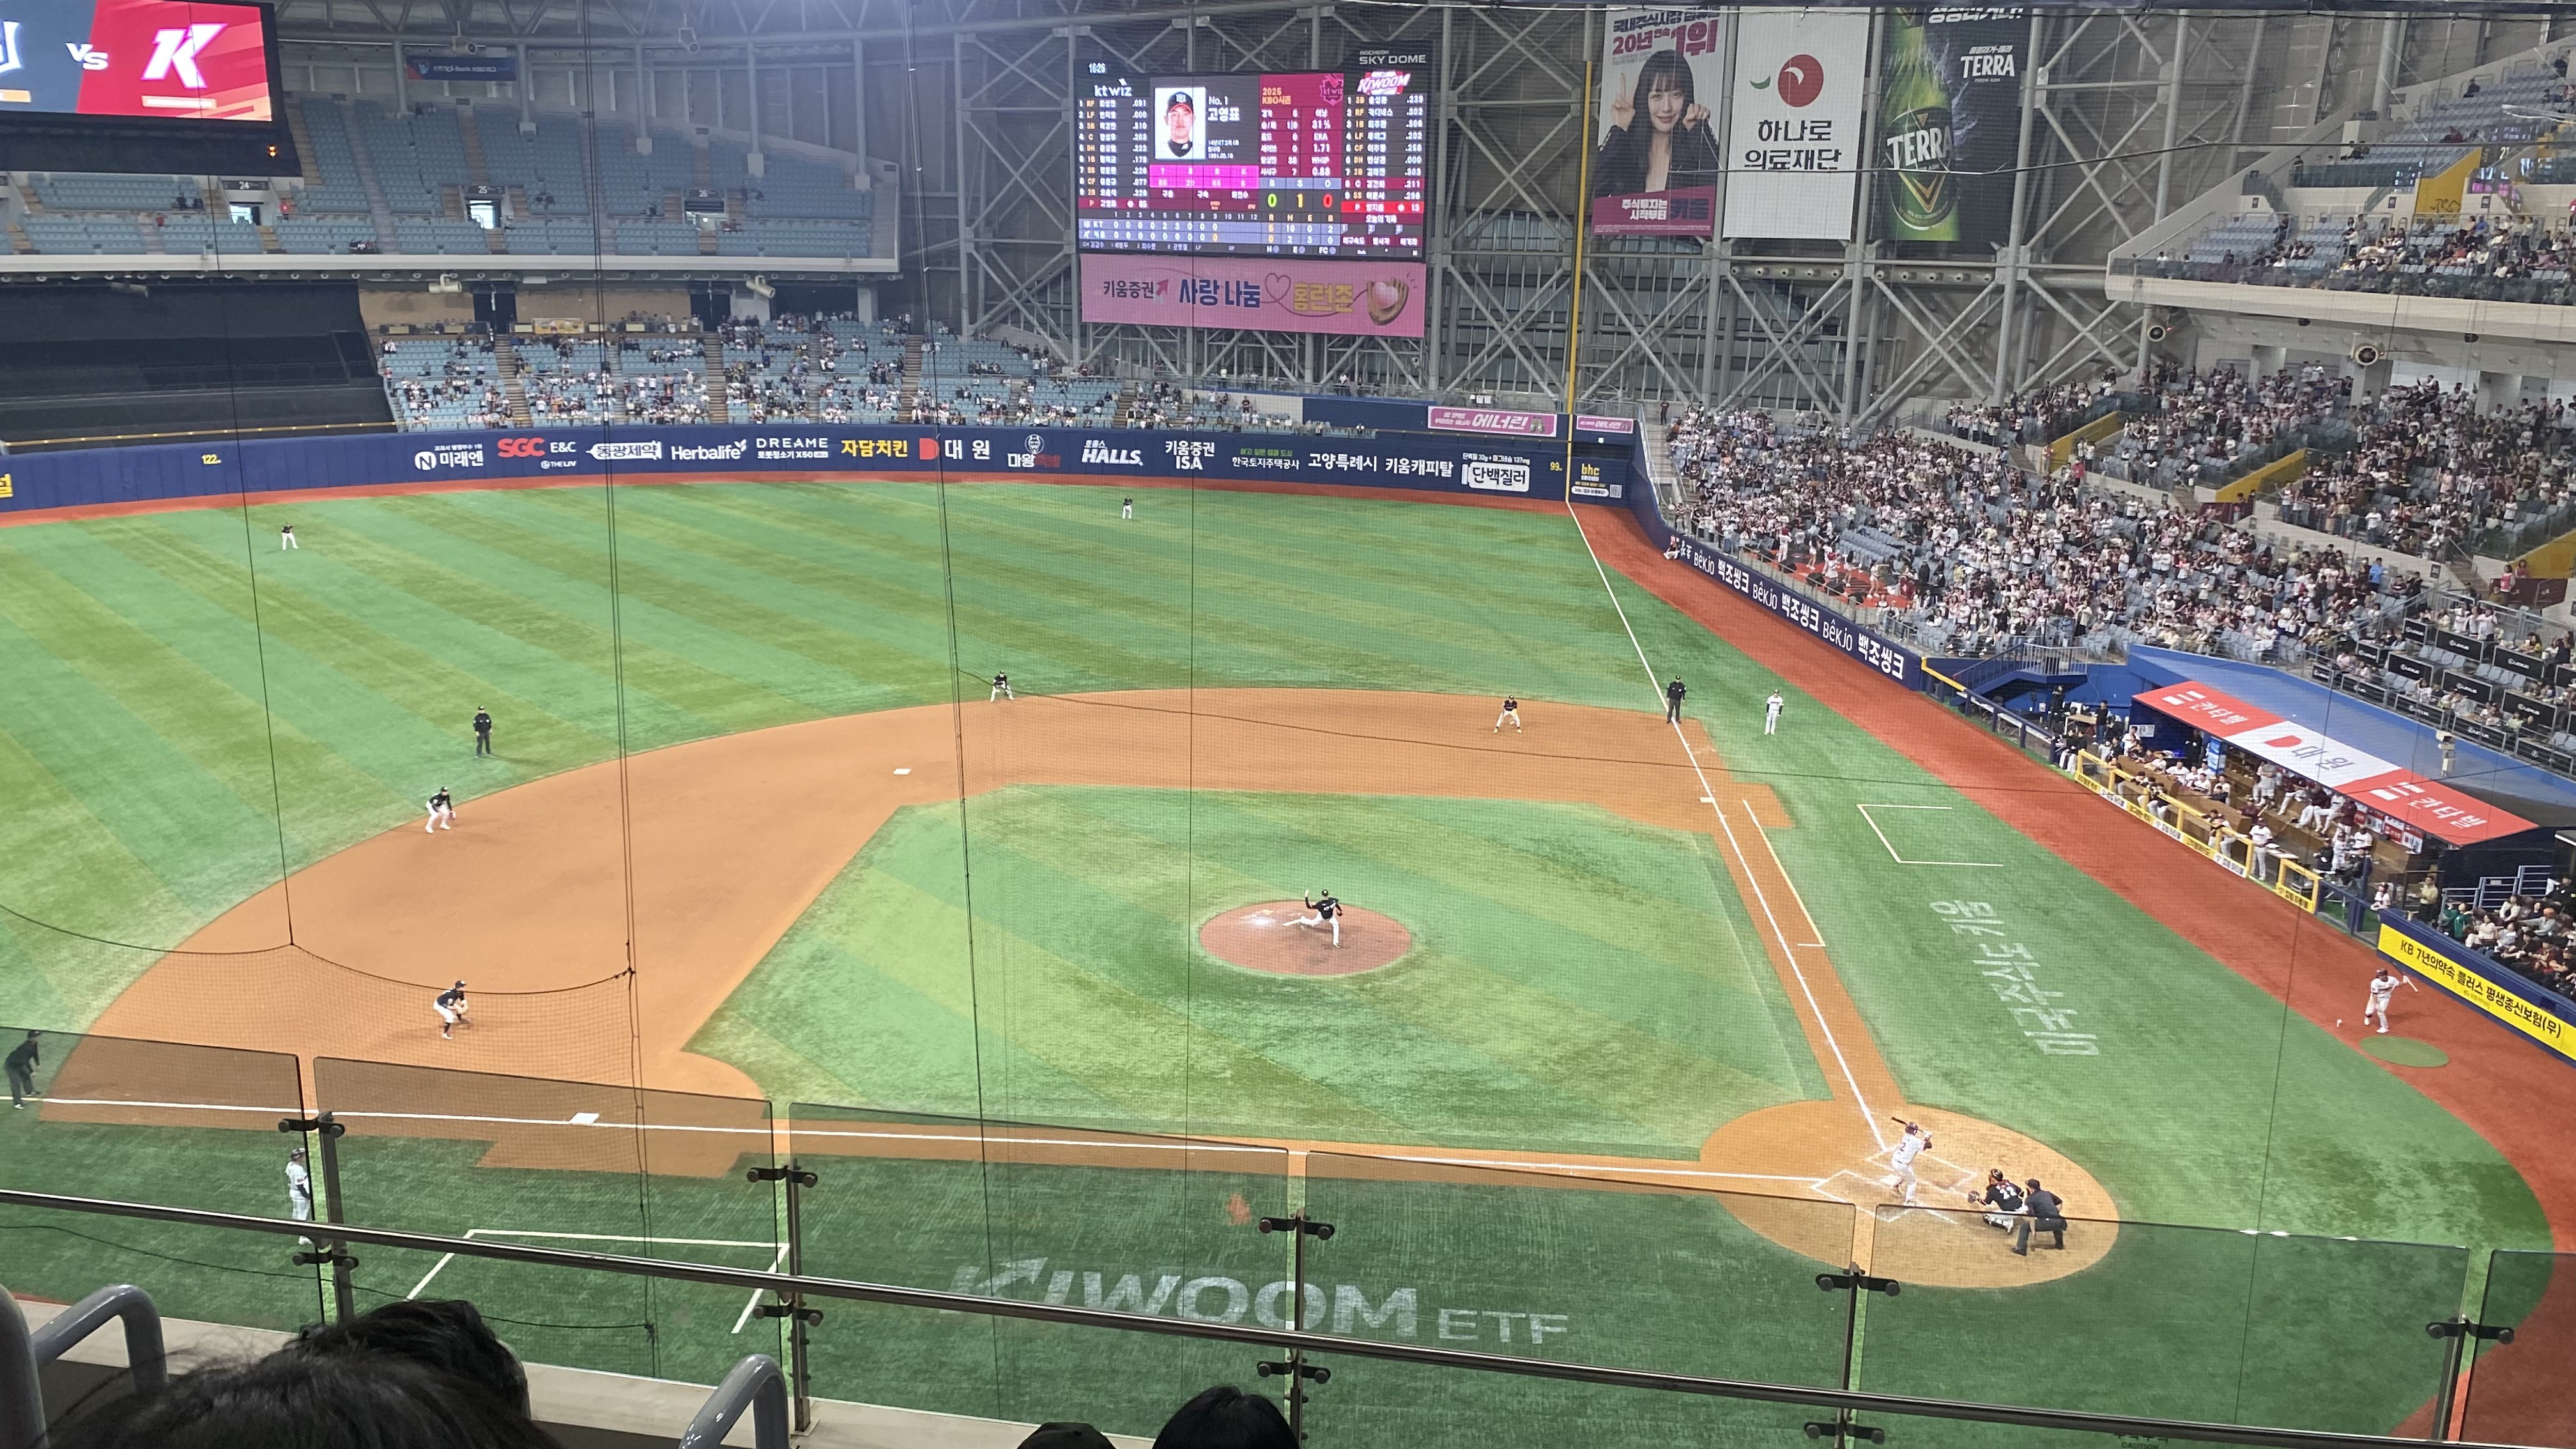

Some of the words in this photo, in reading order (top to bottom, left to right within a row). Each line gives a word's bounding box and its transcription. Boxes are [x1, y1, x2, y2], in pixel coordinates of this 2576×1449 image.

[1613, 30, 1653, 55] 20년
[1671, 19, 1719, 56] 1위
[1360, 56, 1385, 65] SKY
[1388, 54, 1426, 64] DOME
[1960, 54, 2015, 79] TERRA
[1094, 85, 1108, 96] kt
[1108, 78, 1132, 96] wiz
[1357, 72, 1411, 93] KIWOOM
[1209, 96, 1222, 105] No.
[1224, 96, 1228, 105] 1
[1208, 107, 1240, 122] 고영표
[1758, 119, 1832, 142] 하나로
[1313, 143, 1330, 152] 1.71
[1887, 126, 1952, 169] TERRA
[1744, 150, 1842, 170] 의료재단
[478, 185, 487, 194] 25
[1268, 194, 1277, 208] 0
[1297, 194, 1303, 208] 1
[1322, 194, 1333, 208] 0
[1103, 280, 1154, 299] 키움증권
[1179, 279, 1220, 307] 사랑
[1225, 280, 1261, 309] 나눔
[1293, 281, 1354, 314] 홈런존
[1471, 413, 1529, 430] 에너린
[497, 438, 545, 457] SGC
[550, 441, 576, 453] E&C
[596, 445, 658, 457] 동광제약
[756, 438, 828, 448] DREAME
[841, 440, 908, 457] 자담치킨
[1165, 440, 1215, 457] 키움증권
[440, 450, 484, 468] 미래엔
[671, 445, 741, 460] Herbalife
[757, 450, 794, 459] 로봇청소기
[1176, 456, 1203, 470] ISA
[1232, 456, 1300, 470] 한국토지주택공사
[1308, 453, 1377, 471] 고양특례시
[1385, 457, 1453, 477] 키움캐피탈
[1581, 463, 1600, 476] bhc
[1473, 467, 1525, 486] 단백질러
[1718, 558, 1749, 594] 백조씽크
[1781, 592, 1820, 632] 백조씽크
[1858, 632, 1905, 680] 백조씽크
[2189, 701, 2249, 725] 칸타빌
[2408, 797, 2487, 829] 칸타빌
[2400, 939, 2414, 955] KB
[2416, 948, 2455, 979] 7년의약속
[2457, 971, 2483, 995] 플러스
[2487, 986, 2561, 1038] 평생종신보험(무)
[1436, 1308, 1570, 1344] ETF
